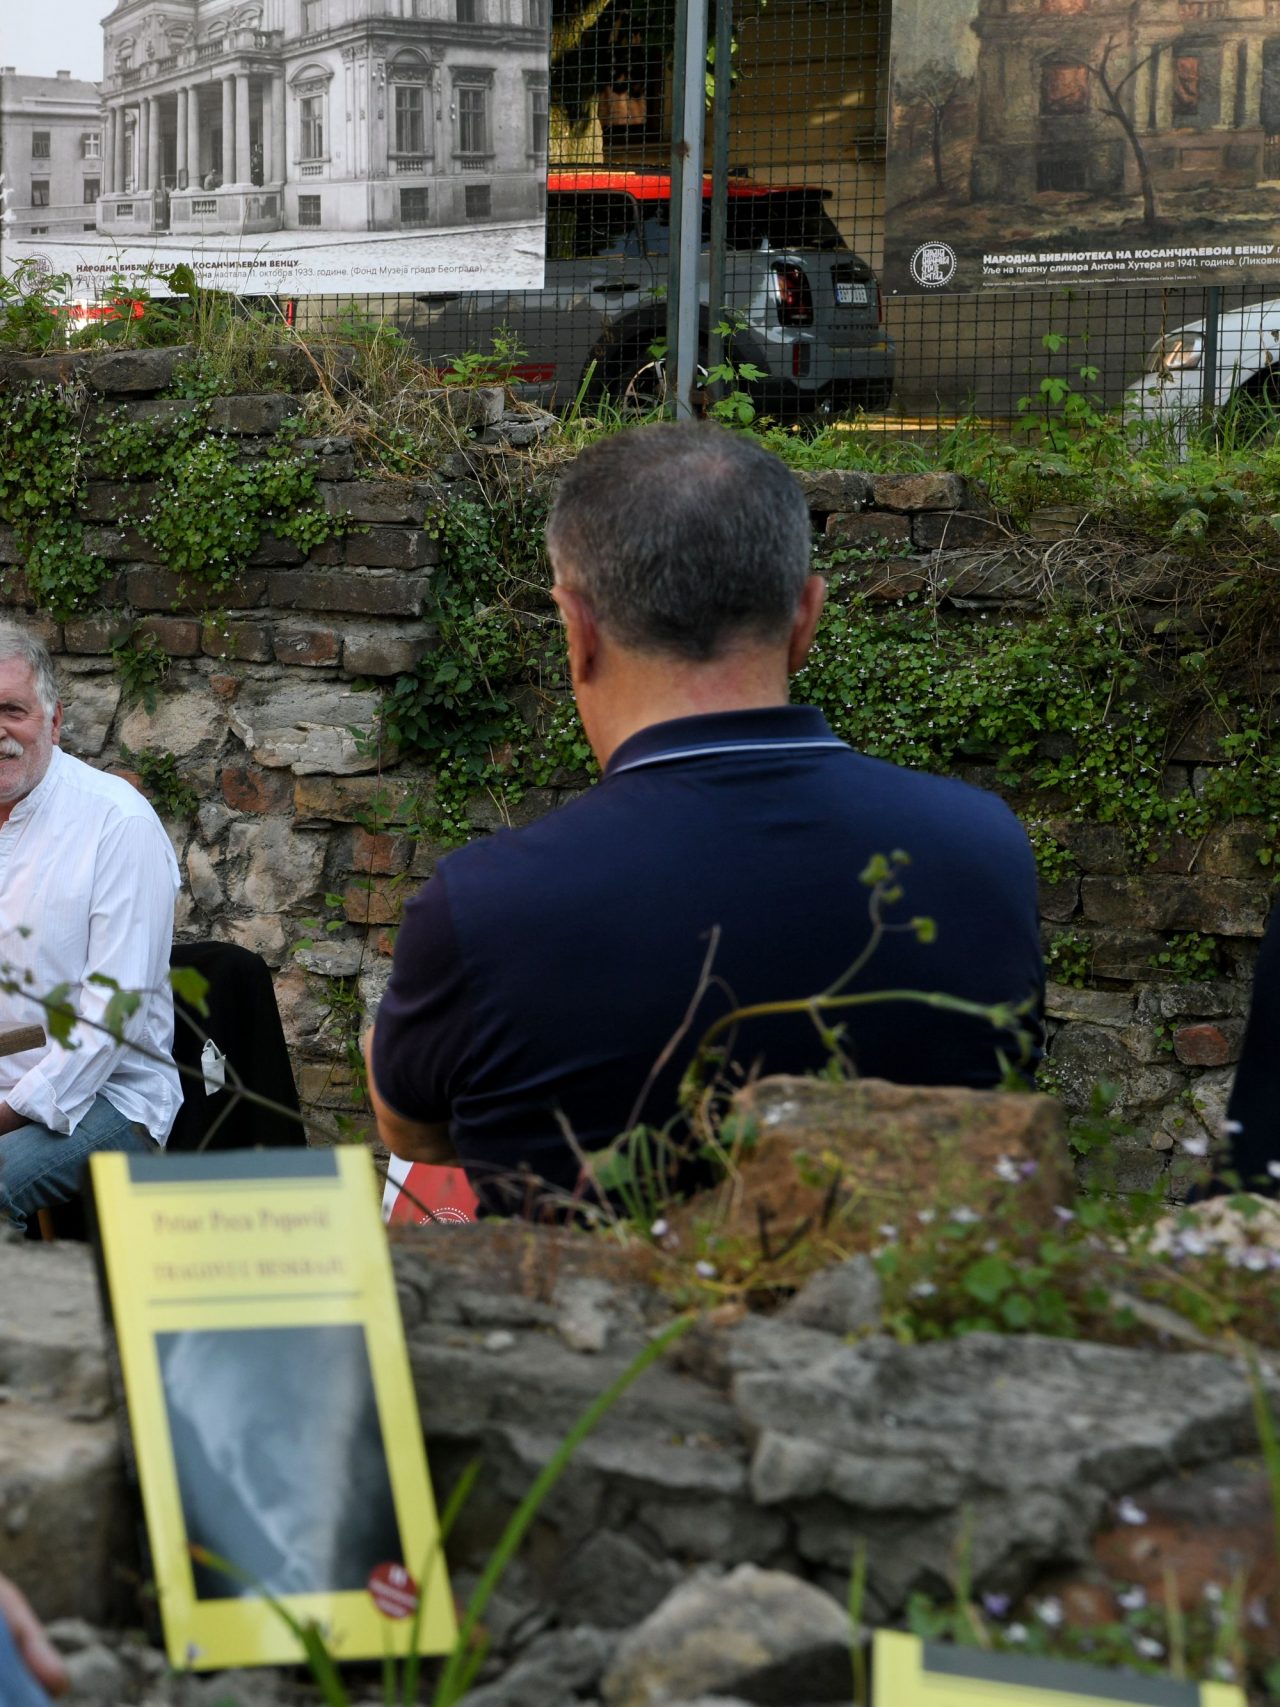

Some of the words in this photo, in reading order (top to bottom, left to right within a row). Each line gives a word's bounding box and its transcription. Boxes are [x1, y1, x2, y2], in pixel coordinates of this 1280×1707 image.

[983, 253, 1037, 264] НАРОДНА
[1039, 251, 1114, 262] БИБЛИОТЕКА
[1116, 250, 1132, 260] НА
[1134, 246, 1232, 259] КОСАНЧИЋЕВОМ
[1234, 245, 1274, 255] ВЕНЦУ
[76, 264, 117, 273] НАРОДНА
[269, 259, 299, 269] ВЕНЦУ
[259, 268, 293, 279] октобра
[295, 267, 315, 277] 1933.
[350, 266, 377, 278] (Фонд
[379, 265, 409, 276] Музеја
[411, 265, 436, 275] града
[438, 264, 483, 274] Београда)
[983, 265, 1001, 275] Уље
[1003, 266, 1014, 274] на
[1016, 265, 1048, 275] платну
[1049, 263, 1089, 273] сликара
[1090, 261, 1126, 271] Антона
[1127, 260, 1162, 271] Хутера
[1164, 260, 1175, 268] из
[1177, 258, 1198, 267] 1941.
[1200, 259, 1237, 268] године.
